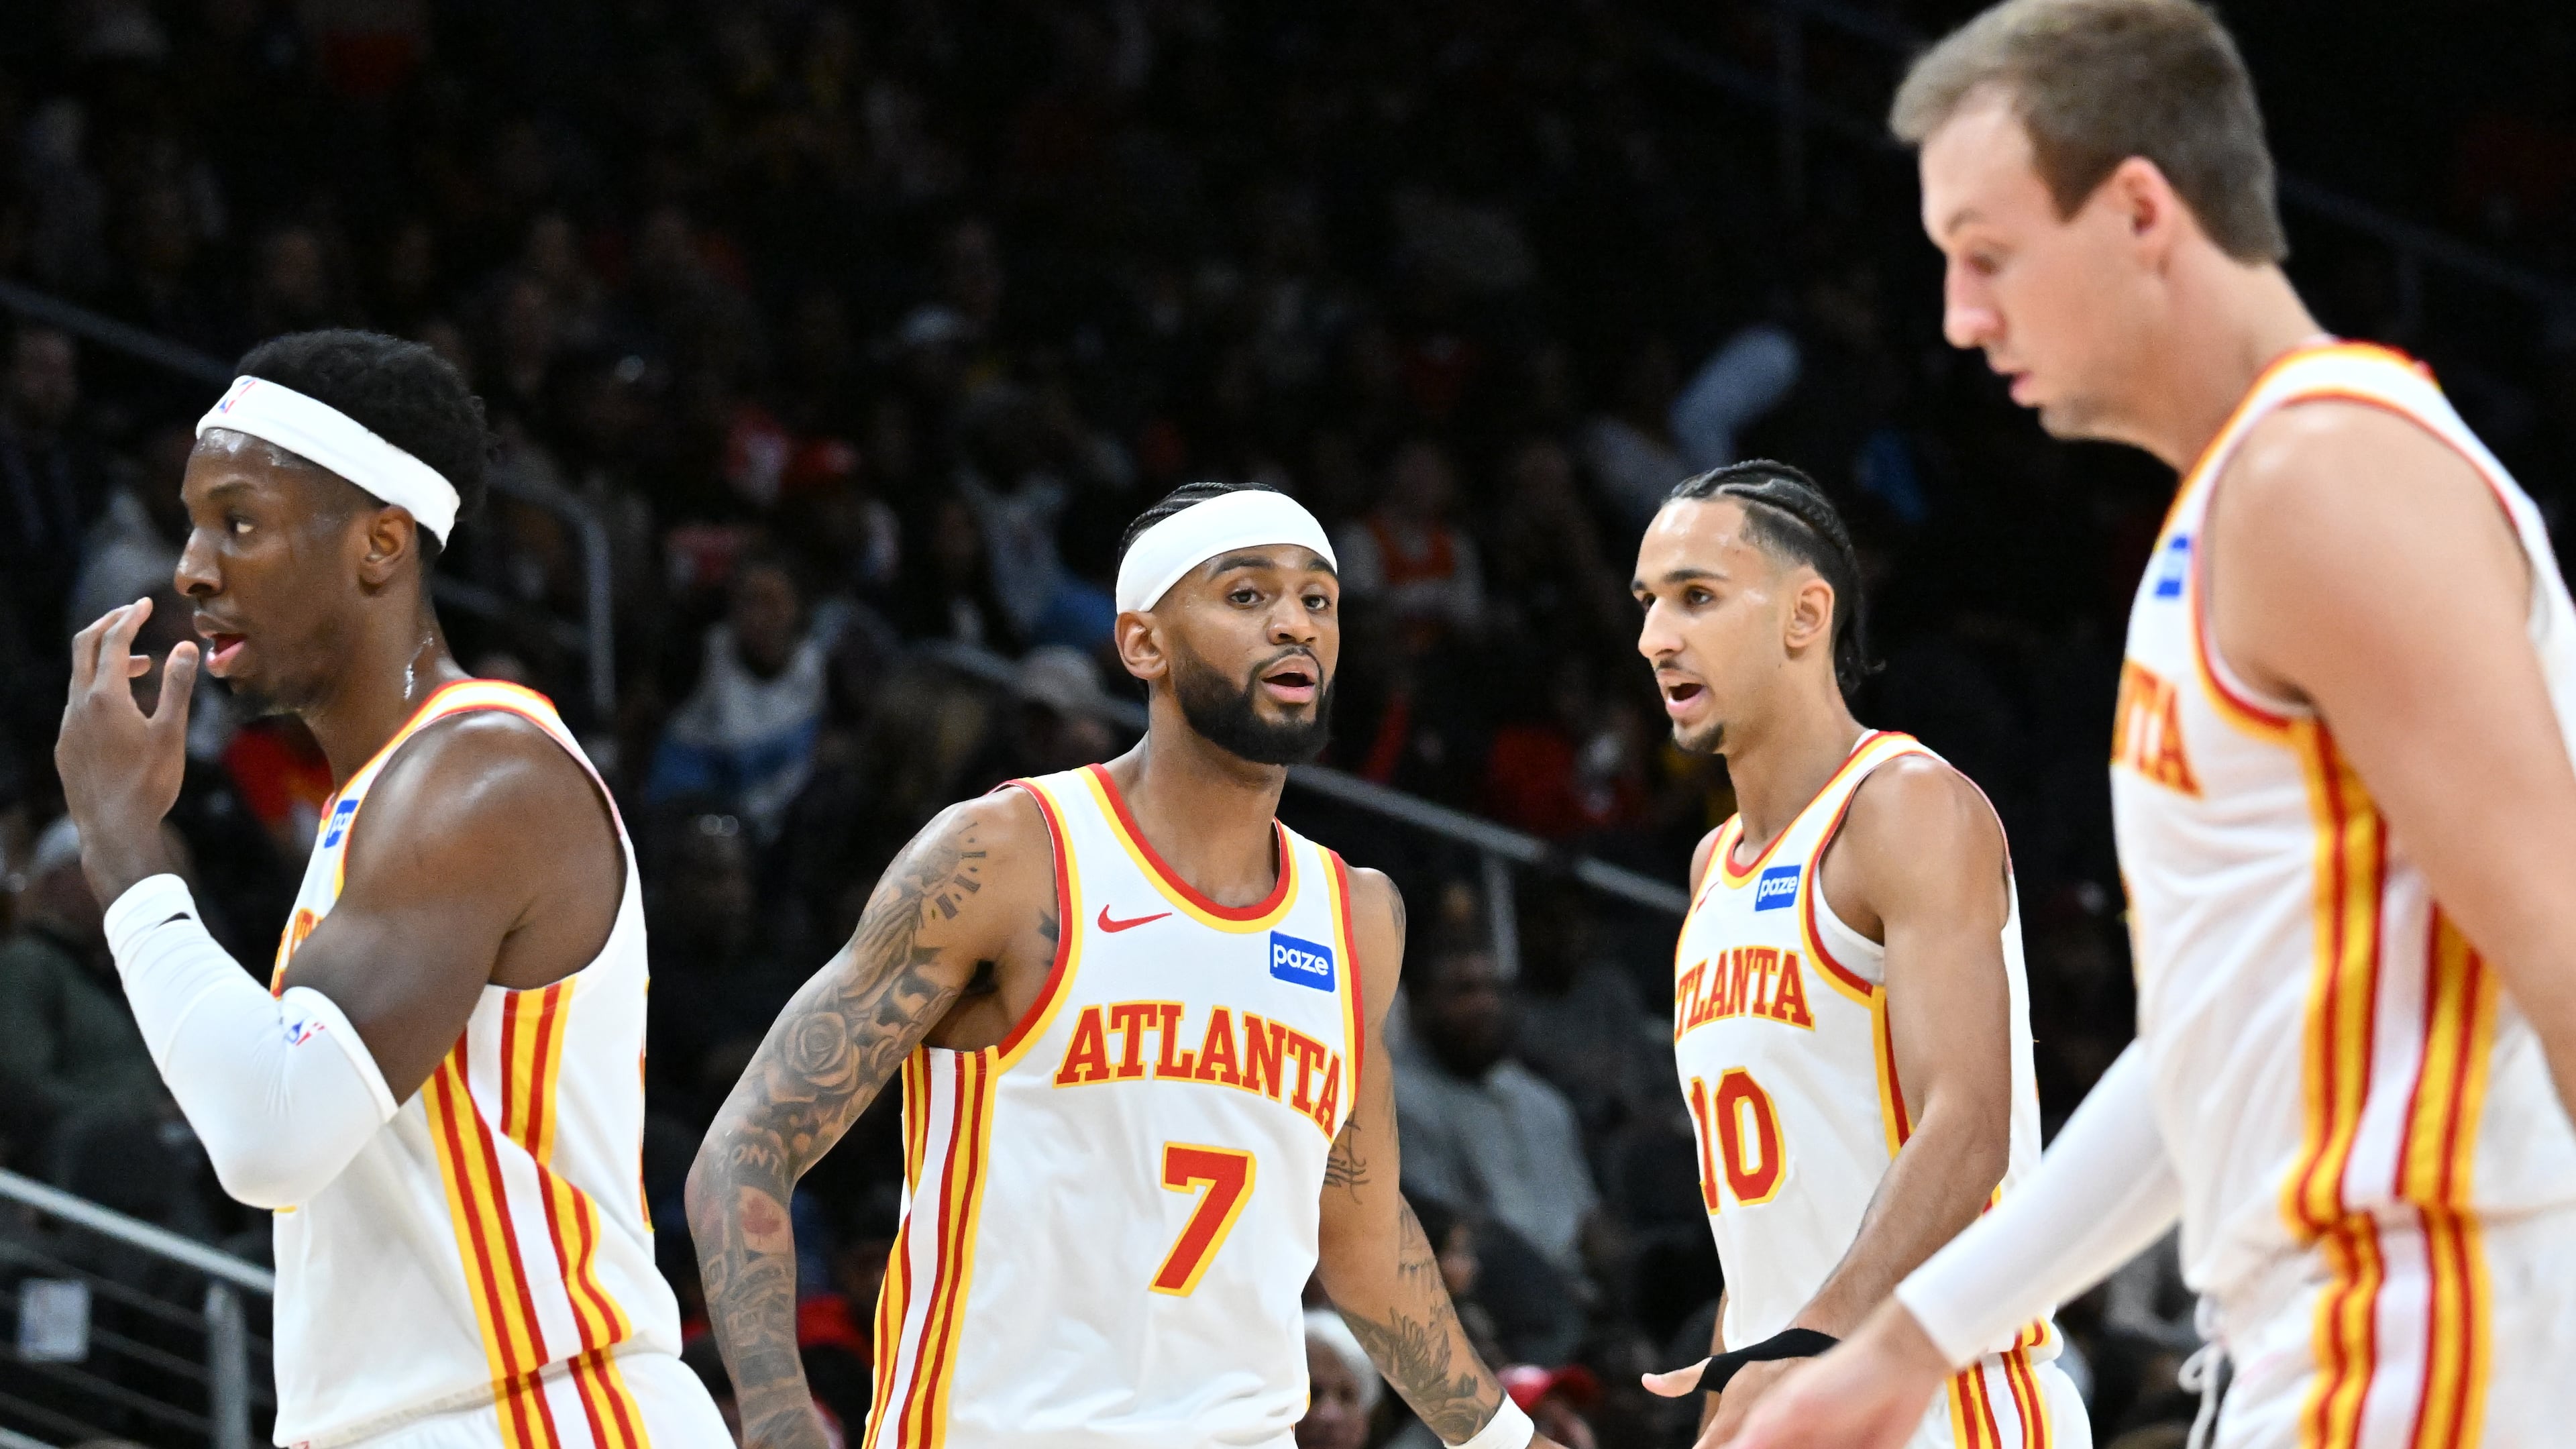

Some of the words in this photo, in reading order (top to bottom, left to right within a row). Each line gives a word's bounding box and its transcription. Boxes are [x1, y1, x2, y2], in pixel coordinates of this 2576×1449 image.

[1760, 875, 1799, 897] paze
[1273, 943, 1330, 977] paze
[1675, 947, 1815, 1044] TLANTA
[1053, 1000, 1342, 1144] ATLANTA
[1690, 1067, 1786, 1214] 10
[1148, 1140, 1257, 1298] 7
